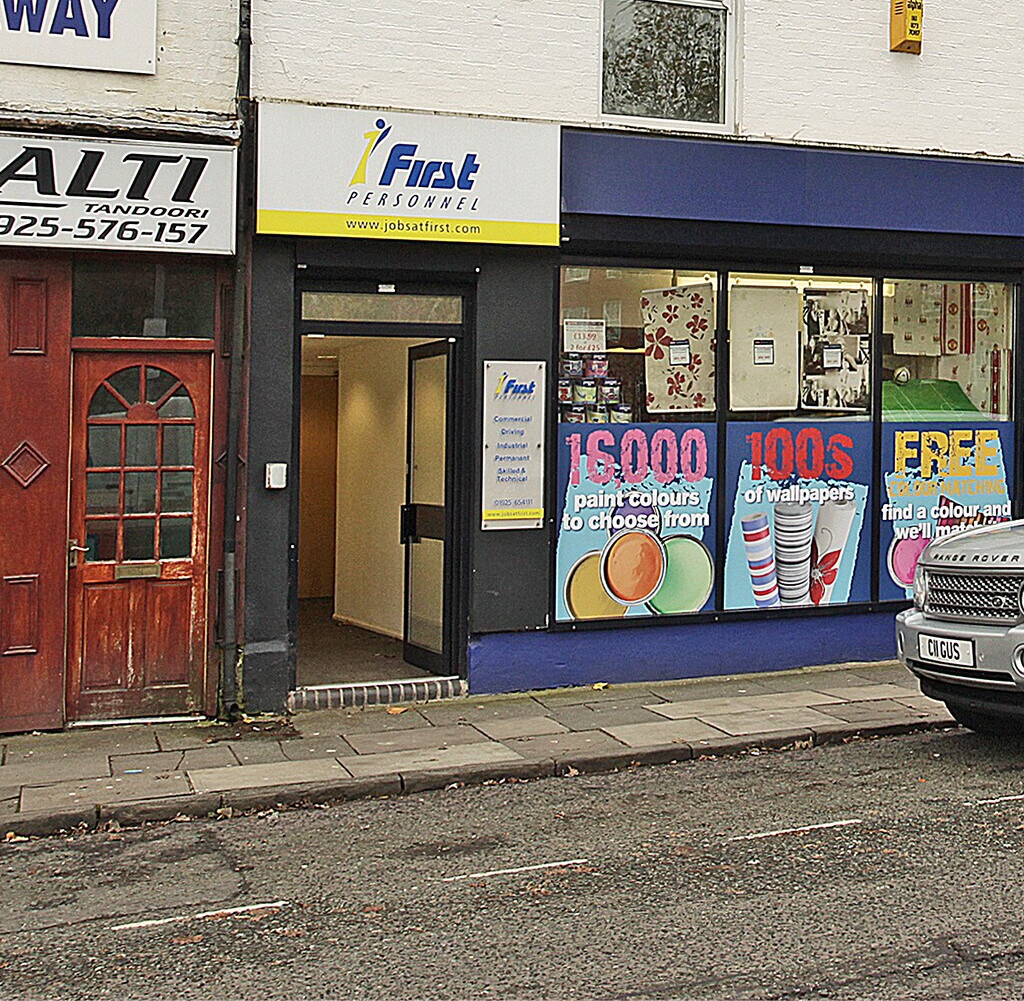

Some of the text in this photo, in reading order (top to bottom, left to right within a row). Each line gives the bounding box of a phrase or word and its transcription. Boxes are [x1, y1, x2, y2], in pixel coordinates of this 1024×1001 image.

[0, 146, 208, 203] ALTI
[379, 144, 480, 190] First
[347, 191, 479, 211] PERSONNEL
[85, 203, 209, 219] TANDOORI
[346, 219, 481, 234] www.jobsatfirst.com
[493, 415, 533, 423] Commercial
[500, 428, 525, 436] Driving
[565, 428, 708, 489] 16,000
[894, 428, 999, 478] FREE
[496, 475, 528, 483] Technical
[940, 478, 1006, 495] MATCHING
[574, 489, 700, 511] paint colours
[744, 485, 854, 504] of wallpapers
[563, 509, 709, 530] to choose from
[881, 500, 1012, 520] find a colour and
[895, 523, 933, 539] we'll
[972, 554, 1020, 562] ROVER
[940, 641, 961, 660] GUS
